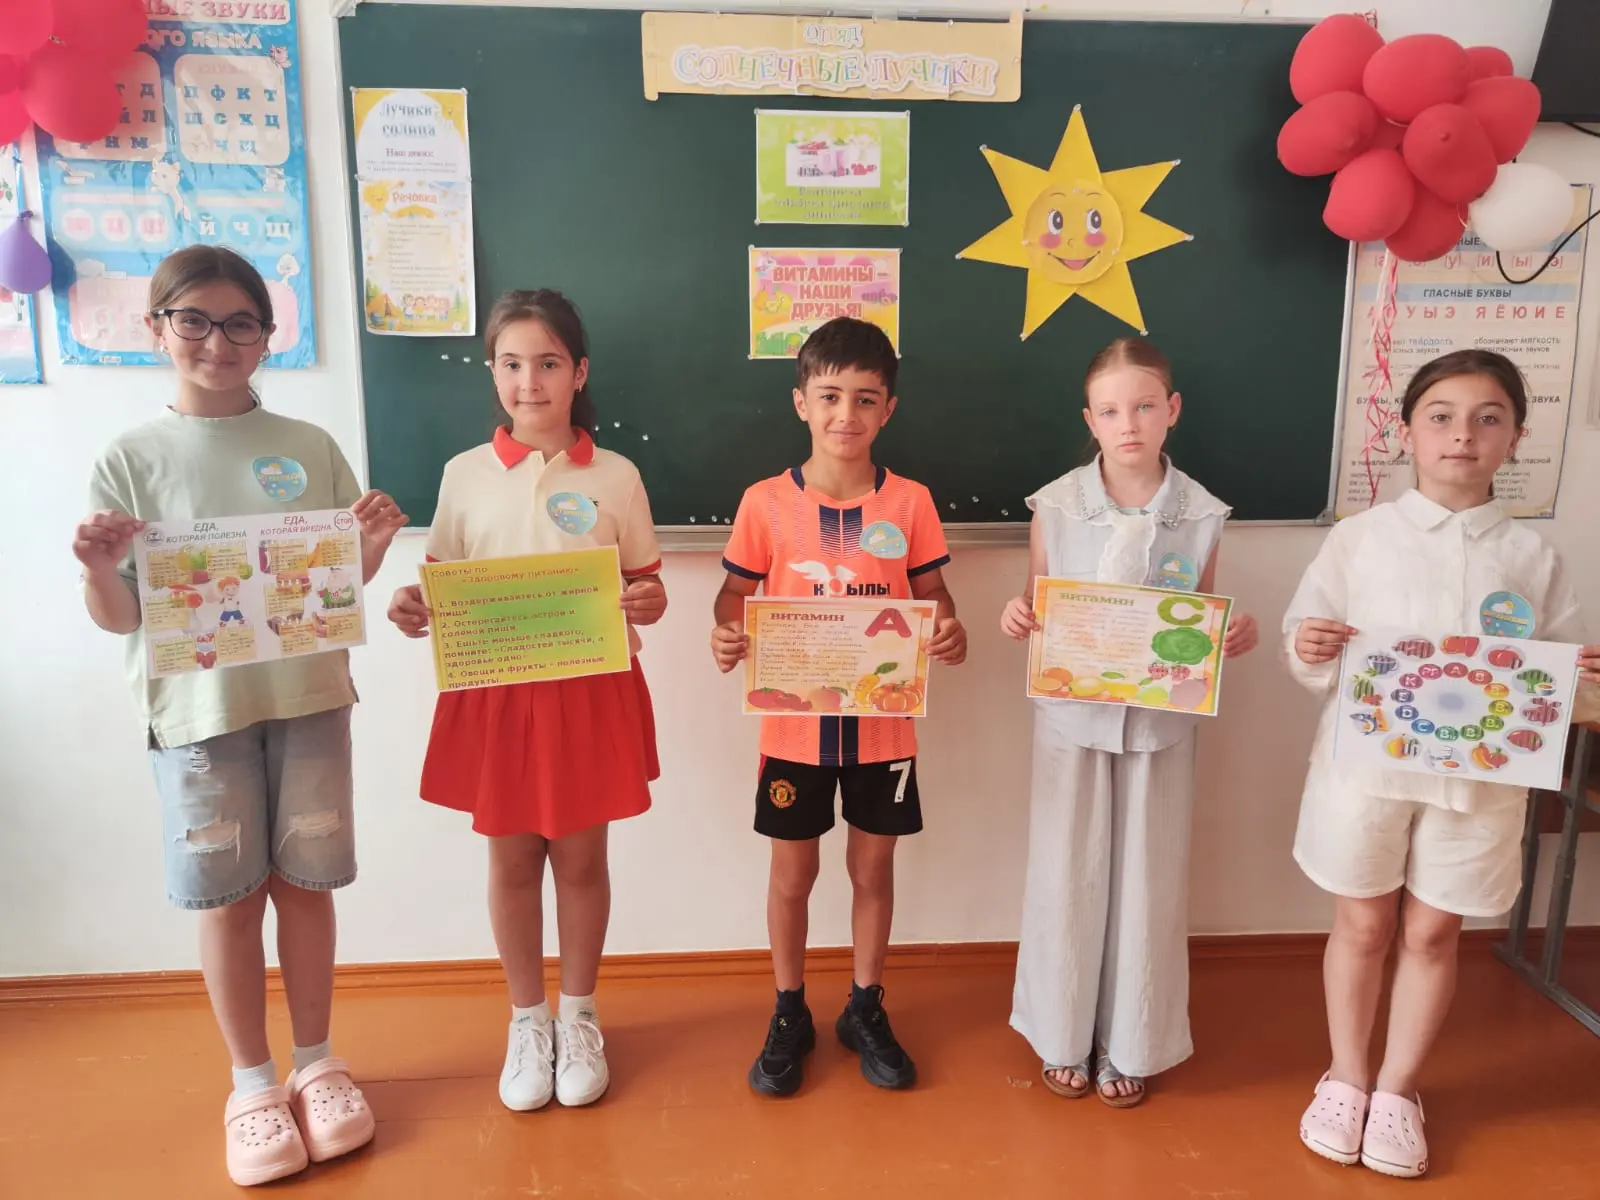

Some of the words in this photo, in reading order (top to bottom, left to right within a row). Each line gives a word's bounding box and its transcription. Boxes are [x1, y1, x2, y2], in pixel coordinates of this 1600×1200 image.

[201, 1, 287, 20] ЗВУКИ
[191, 30, 263, 49] ЯЗЫКА
[678, 52, 861, 83] СОЛНЕЧНЫЕ
[872, 58, 989, 88] ЛУЧИКИ
[773, 267, 874, 282] ВИТАМИНЫ
[800, 285, 852, 300] НАШИ
[1423, 288, 1473, 298] ГЛАСНЫЕ
[1476, 288, 1512, 298] БУКВЫ
[791, 302, 863, 320] ДРУЗЬЯ!
[1532, 395, 1561, 404] ЗВУКА
[166, 534, 206, 544] КОТОРАЯ
[208, 530, 248, 540] ПОЛЕЗНА
[260, 527, 299, 537] КОТОРАЯ
[431, 568, 472, 577] Советы
[460, 668, 496, 678] Овощи
[507, 662, 547, 674] фрукты
[889, 759, 912, 803] 7
